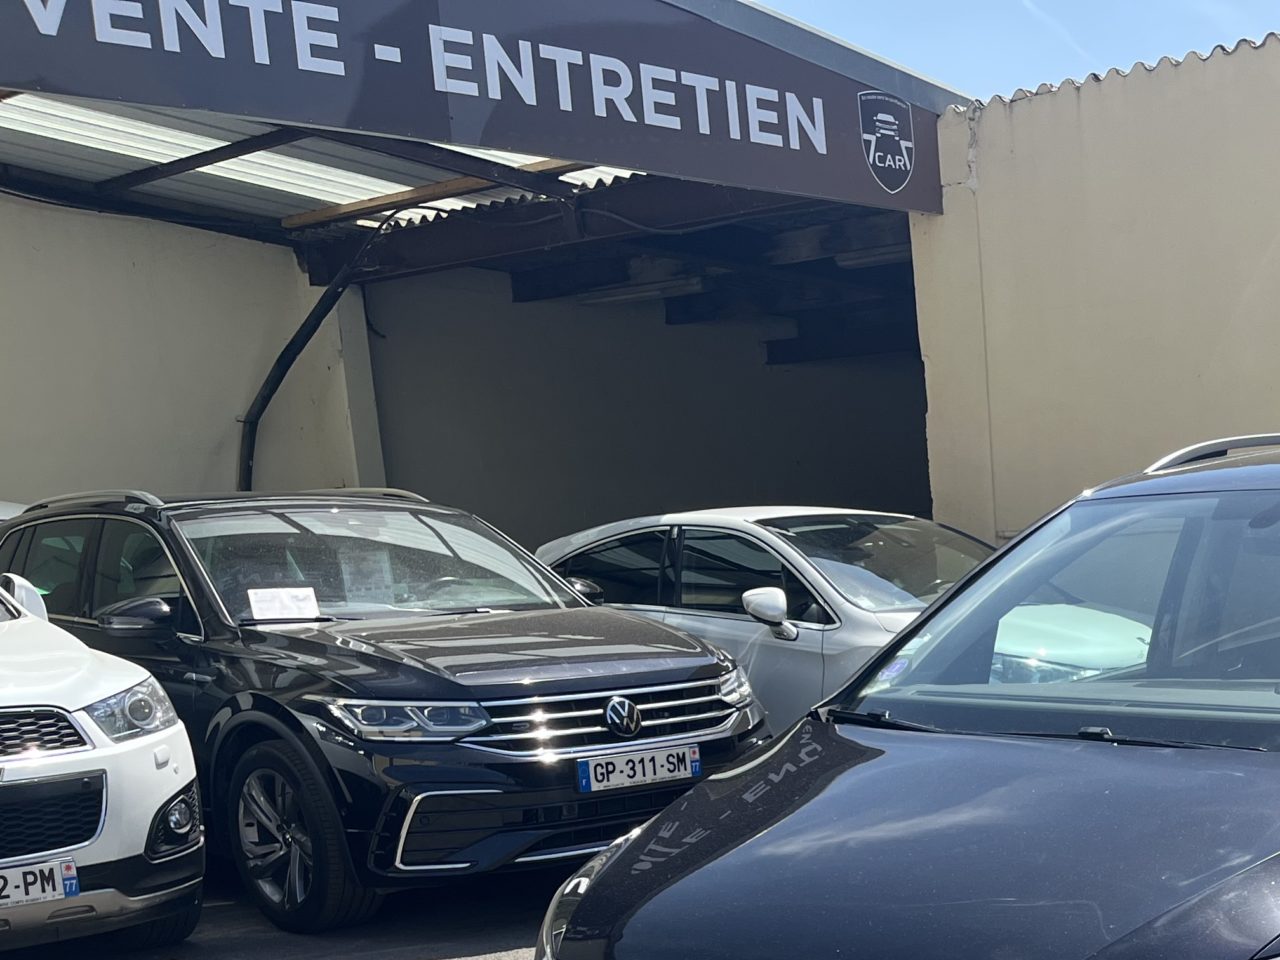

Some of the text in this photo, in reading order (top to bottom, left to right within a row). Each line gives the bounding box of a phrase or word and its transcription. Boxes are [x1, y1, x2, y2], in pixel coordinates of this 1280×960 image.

[429, 24, 827, 155] ENTRETIEN
[593, 751, 688, 784] GP-311-SM
[691, 762, 700, 773] 77
[64, 880, 77, 893] 77
